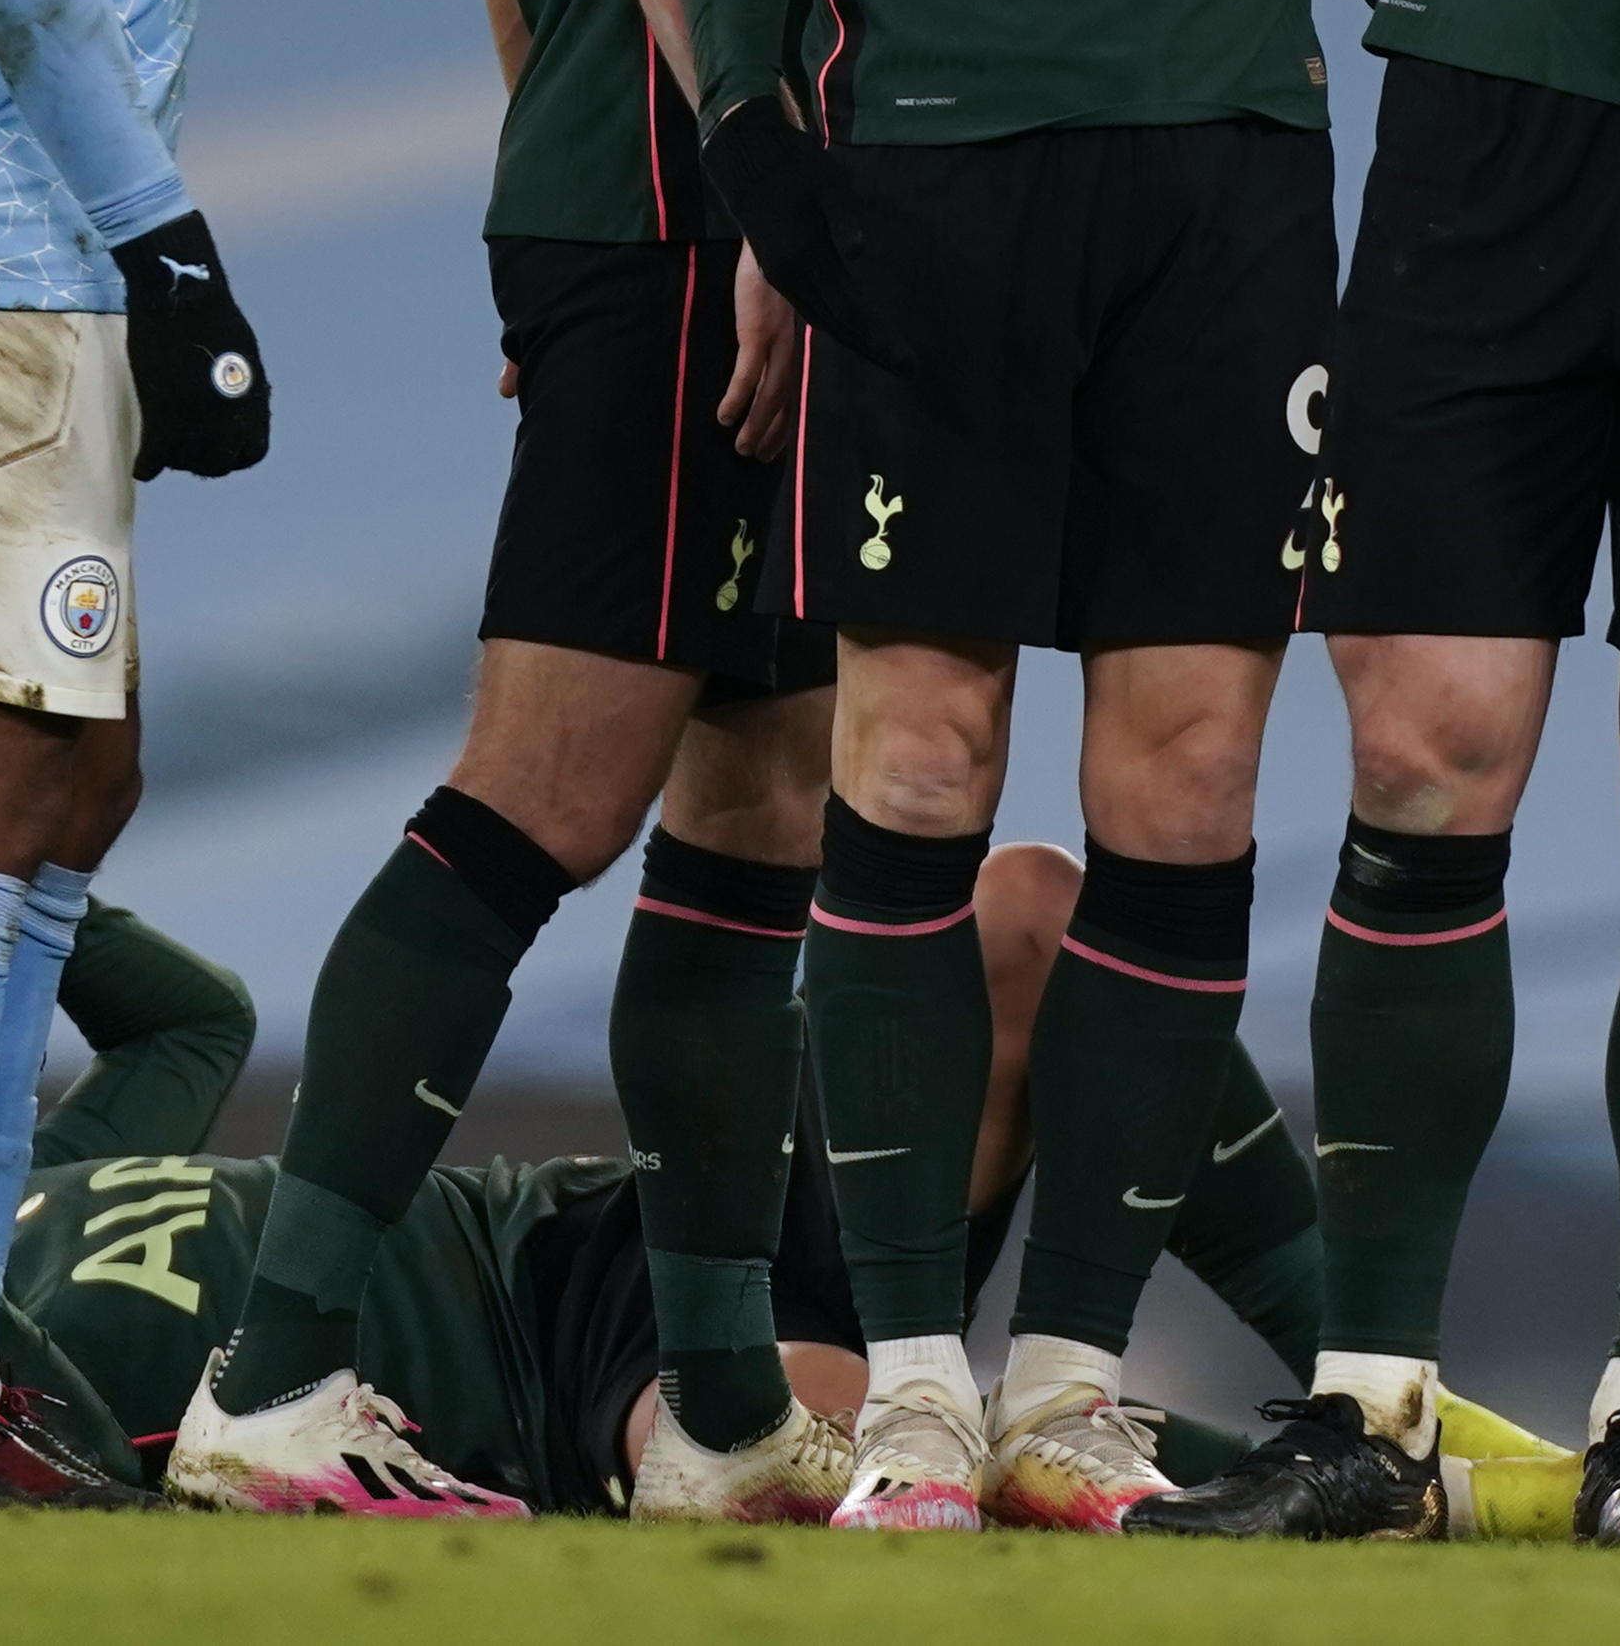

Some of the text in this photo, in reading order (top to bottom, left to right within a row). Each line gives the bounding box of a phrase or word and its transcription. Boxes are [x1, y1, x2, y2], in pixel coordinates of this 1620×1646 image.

[55, 563, 116, 597] MANCHESTER
[70, 639, 96, 650] CITY
[70, 1155, 215, 1316] AIA
